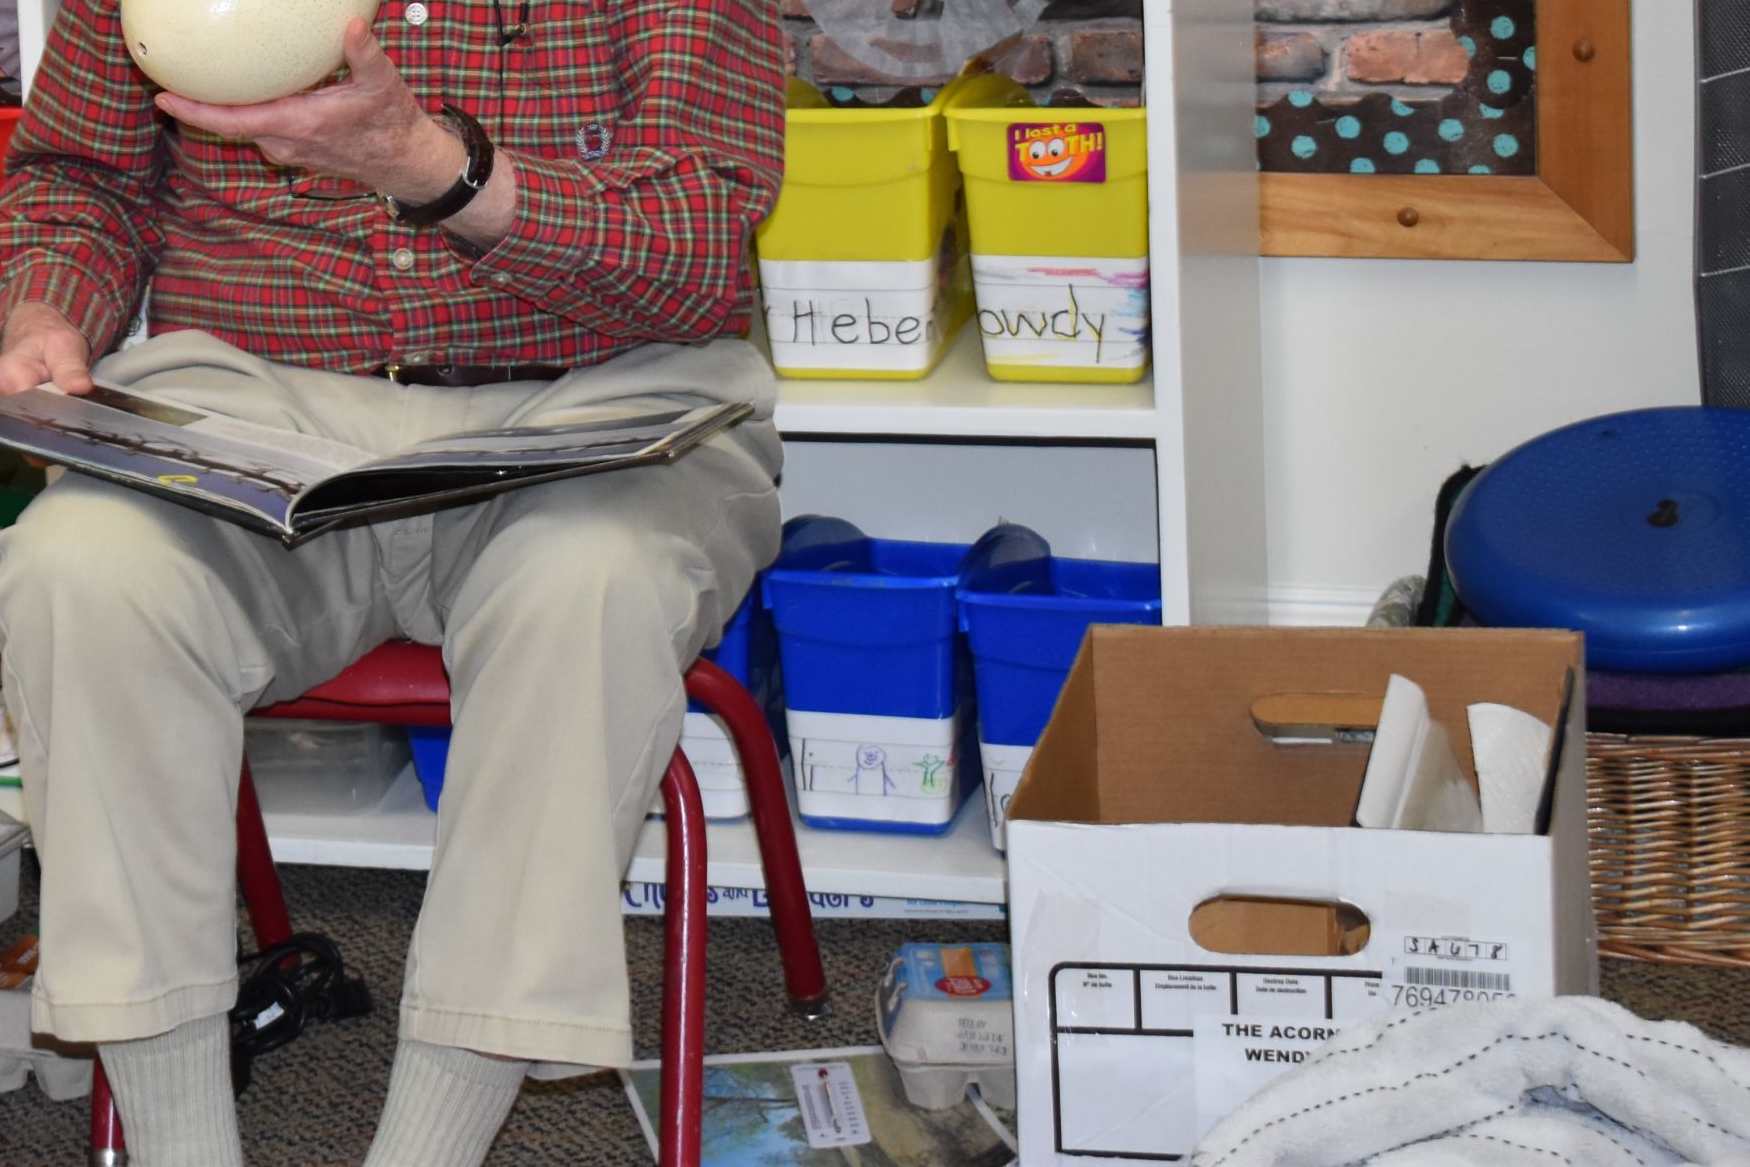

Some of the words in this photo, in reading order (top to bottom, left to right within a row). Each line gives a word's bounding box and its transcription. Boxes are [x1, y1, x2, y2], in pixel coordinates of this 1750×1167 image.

[1014, 129, 1021, 141] I
[1025, 124, 1061, 139] lost
[1064, 123, 1077, 133] a
[1222, 1023, 1263, 1038] THE
[1244, 1047, 1311, 1064] WEND
